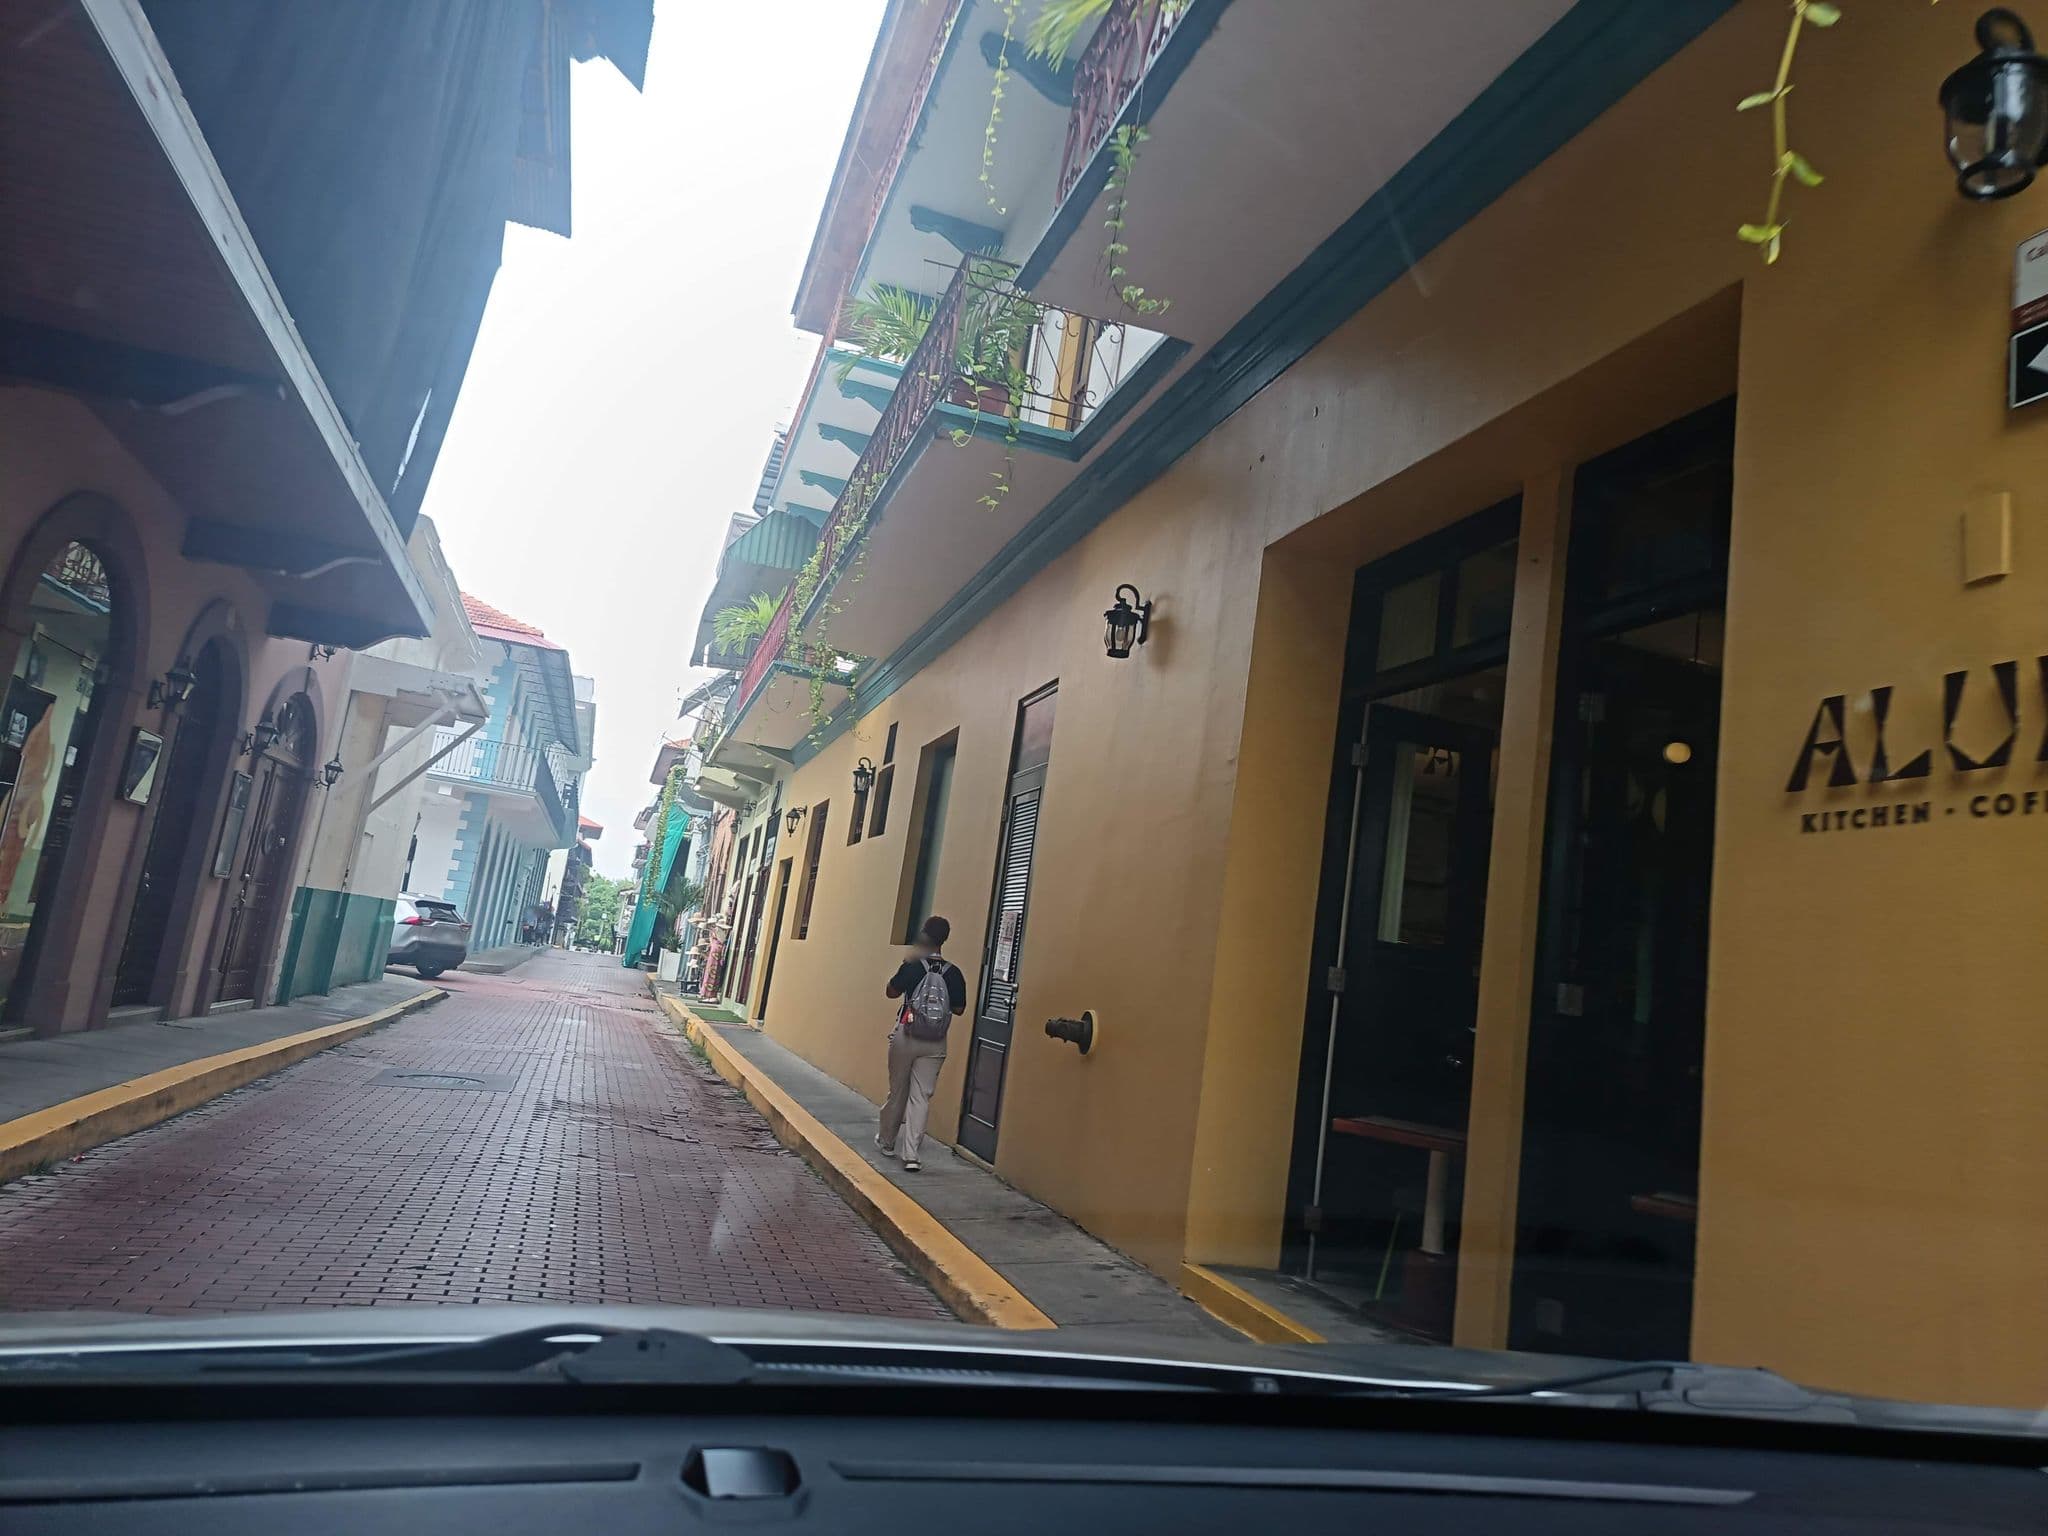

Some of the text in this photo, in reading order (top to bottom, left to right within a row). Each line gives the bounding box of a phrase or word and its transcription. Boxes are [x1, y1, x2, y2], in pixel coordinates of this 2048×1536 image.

[1786, 656, 2048, 792] ALU
[1800, 791, 2048, 834] KITCHEN COF
